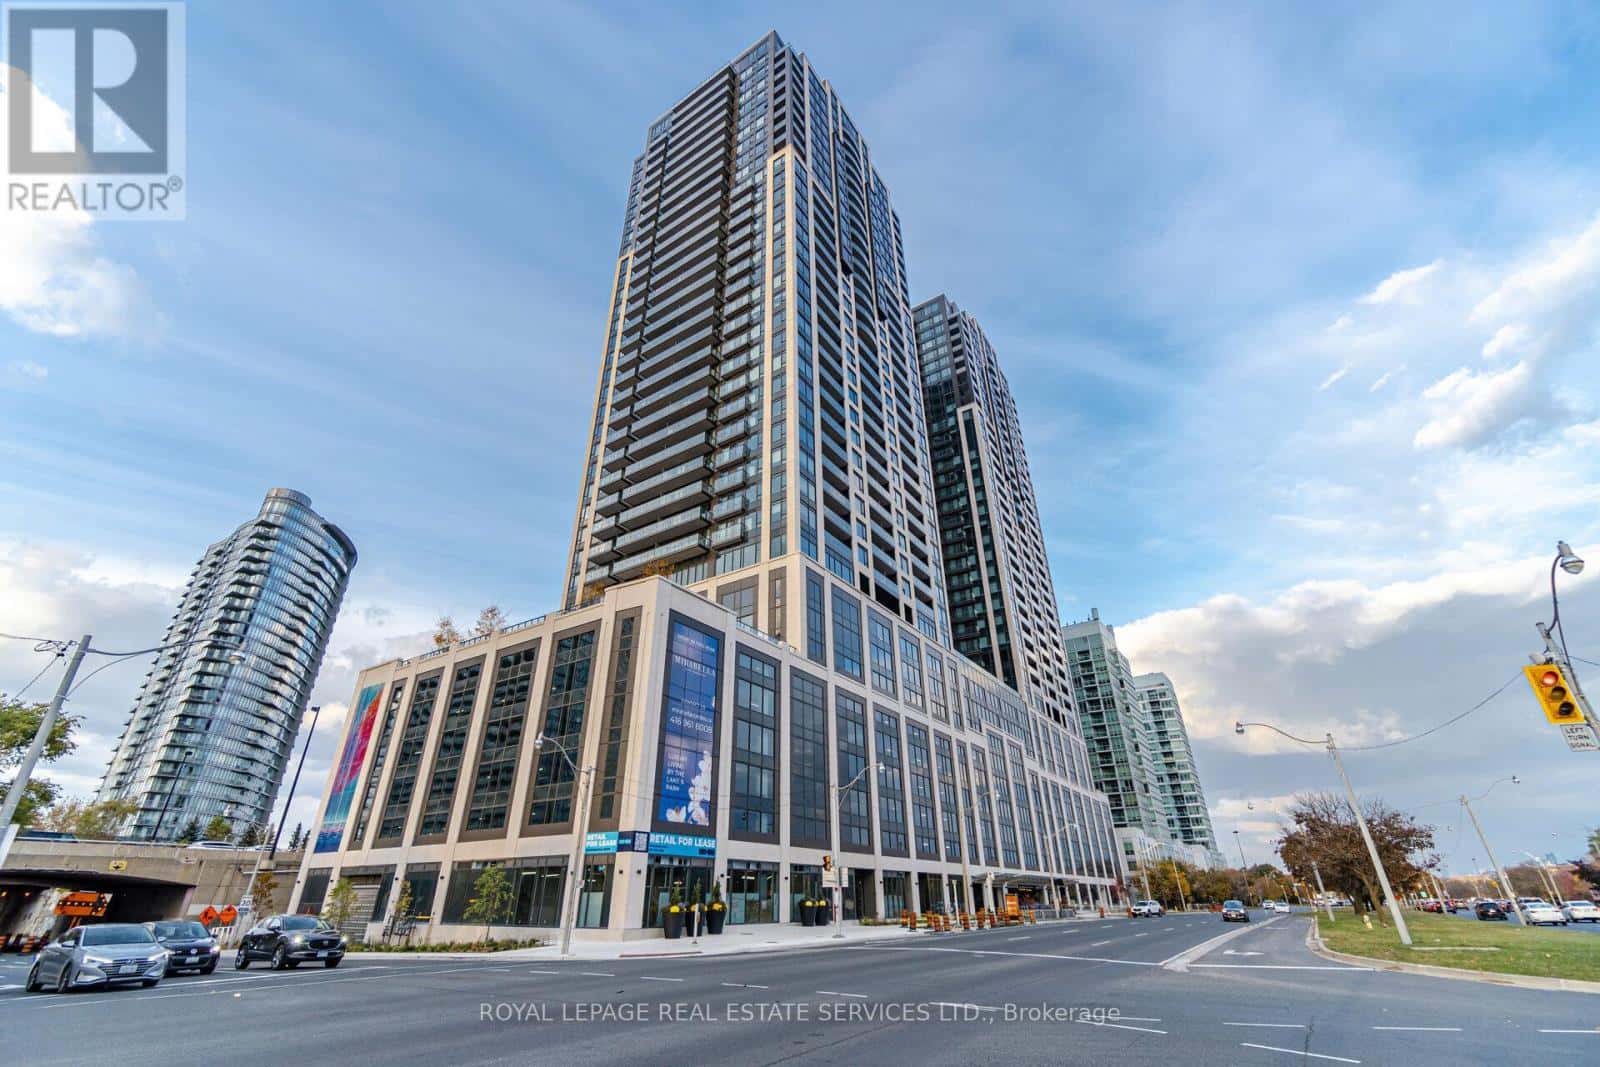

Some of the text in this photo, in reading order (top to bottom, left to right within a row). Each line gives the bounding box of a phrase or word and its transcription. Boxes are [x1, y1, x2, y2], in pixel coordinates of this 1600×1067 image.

[650, 833, 716, 848] RETAIL FOR LEASE
